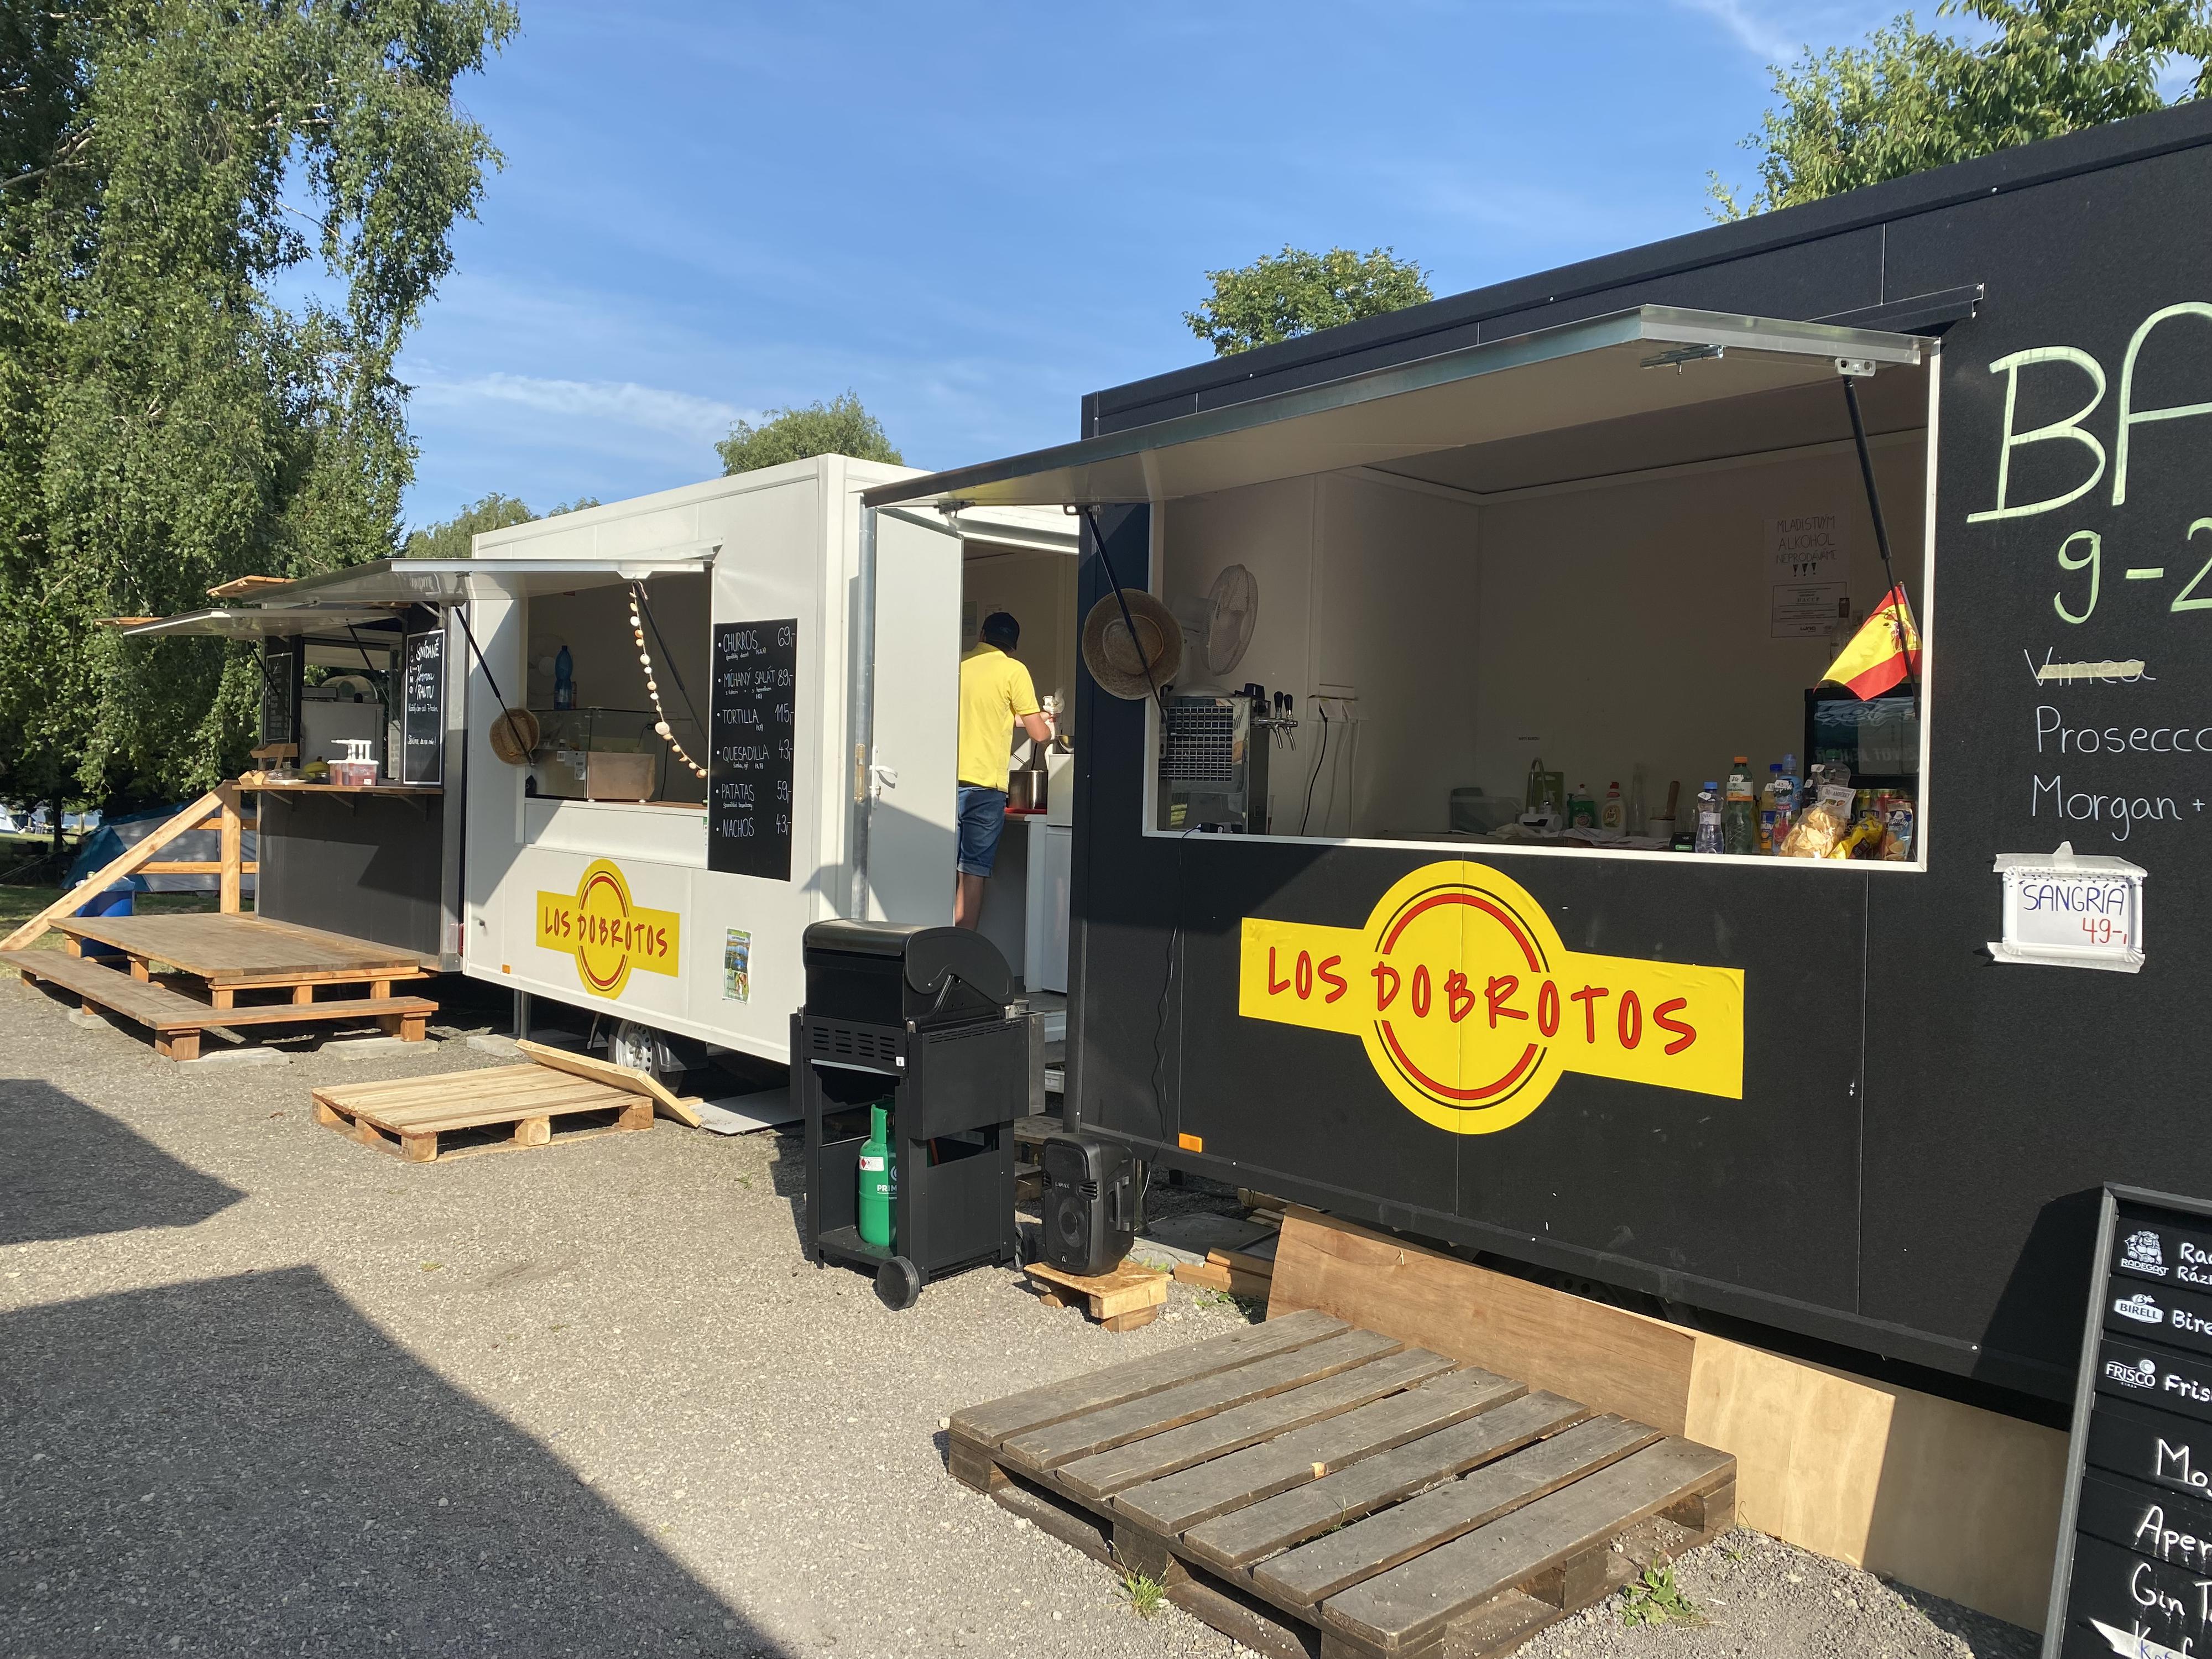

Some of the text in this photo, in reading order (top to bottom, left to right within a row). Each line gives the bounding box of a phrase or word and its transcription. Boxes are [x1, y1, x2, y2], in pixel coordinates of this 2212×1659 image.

[1778, 533, 1835, 551] ALKOHOL
[416, 637, 440, 661] SNÍDANĚ
[723, 630, 758, 653] CHURROS
[723, 667, 752, 687] MÍCHANÝ
[754, 665, 775, 685] SALÁT
[416, 684, 435, 701] RAUTU
[722, 708, 759, 724] TORTILLA
[722, 744, 770, 763] QUESADILLA
[721, 783, 755, 801] PATATAS
[2032, 774, 2183, 843] Morgan
[722, 817, 754, 838] NACHOS
[2022, 883, 2125, 916] SANGRÍA
[545, 906, 668, 958] LOS DOBROTOS
[1268, 947, 1698, 1056] LOS DOBROTOS
[2121, 1258, 2169, 1276] RADEGAST
[2120, 1303, 2158, 1319] BIRELL
[2105, 1363, 2156, 1387] FRISCO
[2132, 1562, 2185, 1616] Gin
